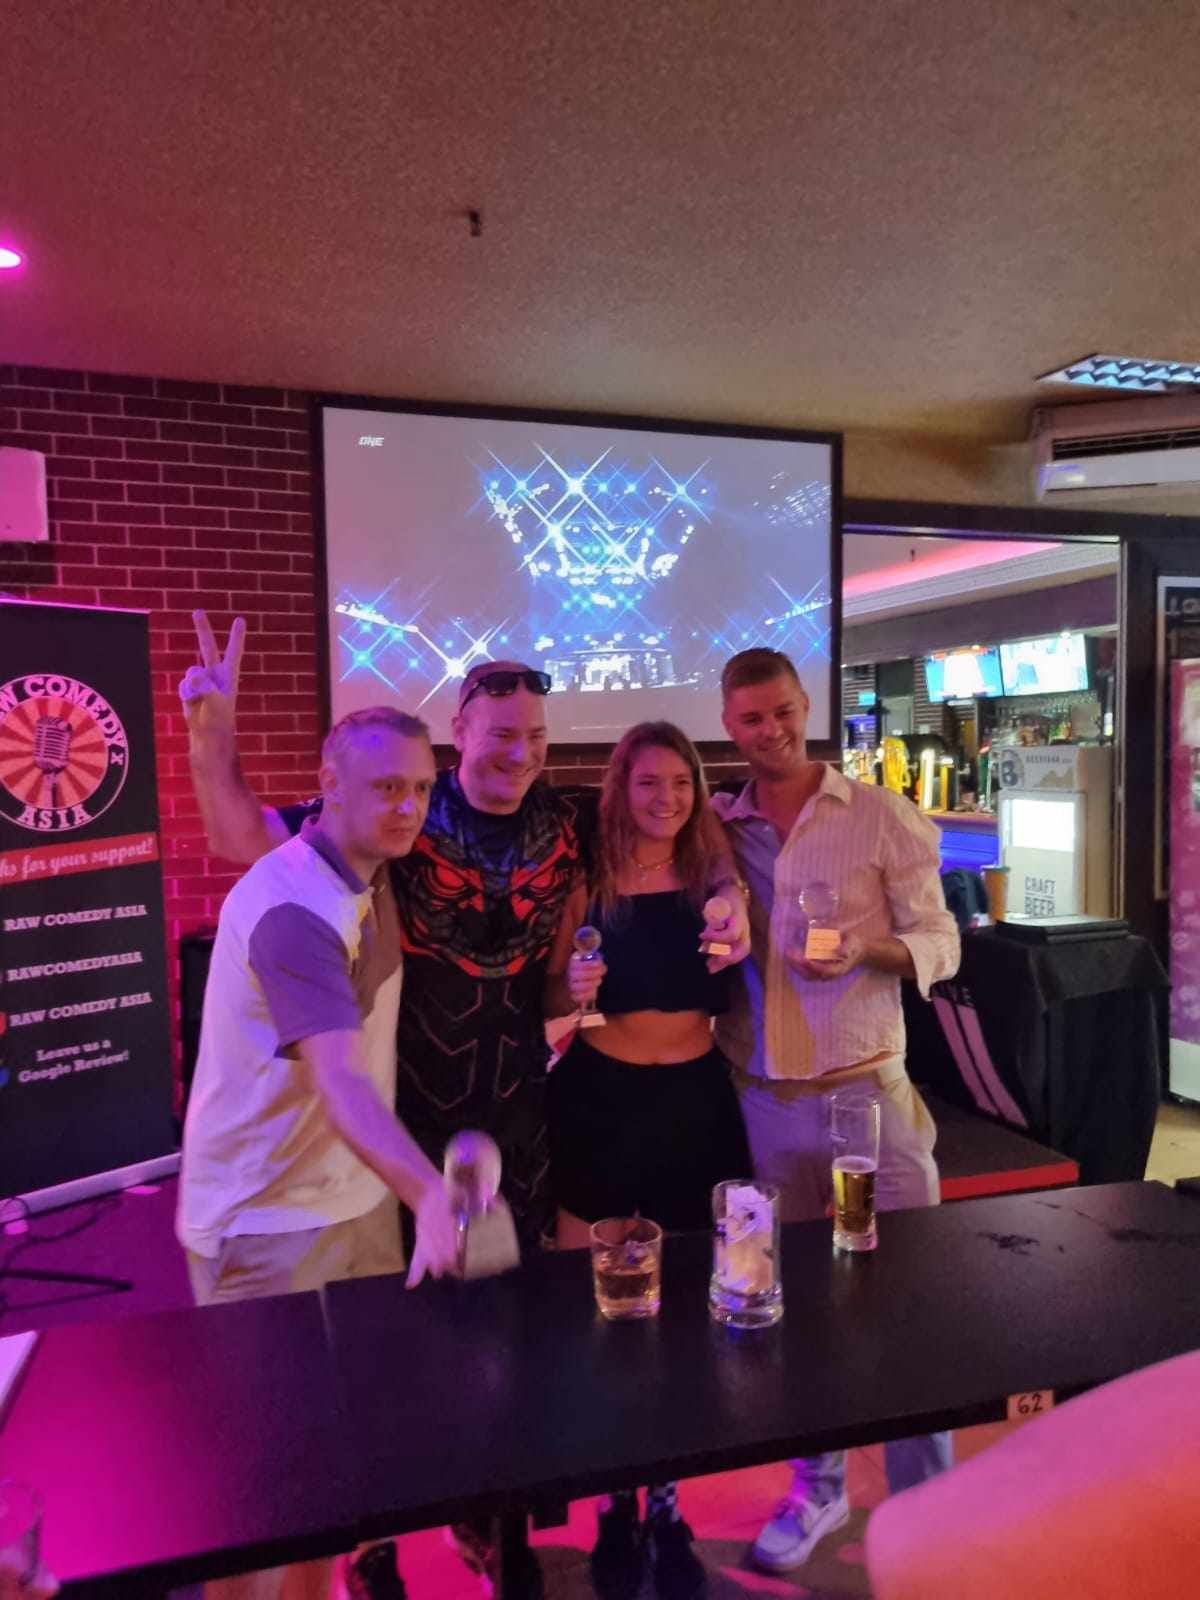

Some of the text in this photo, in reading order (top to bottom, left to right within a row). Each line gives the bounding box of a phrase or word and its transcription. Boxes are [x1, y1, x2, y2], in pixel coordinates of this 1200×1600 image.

[23, 676, 126, 747] COMEDY
[16, 803, 93, 829] ASIA
[22, 854, 47, 880] for
[49, 852, 88, 876] your
[91, 837, 154, 866] support!
[1024, 876, 1056, 895] CRAFT
[4, 904, 148, 932] RAW COMEDY ASIA
[1024, 896, 1056, 918] BEER
[7, 951, 143, 982] RAWCOMEDYASIA
[9, 992, 152, 1028] RAW COMEDY ASIA
[36, 1039, 112, 1062] Leave us a
[18, 1050, 130, 1083] Google Review!
[1017, 1393, 1043, 1415] 62
